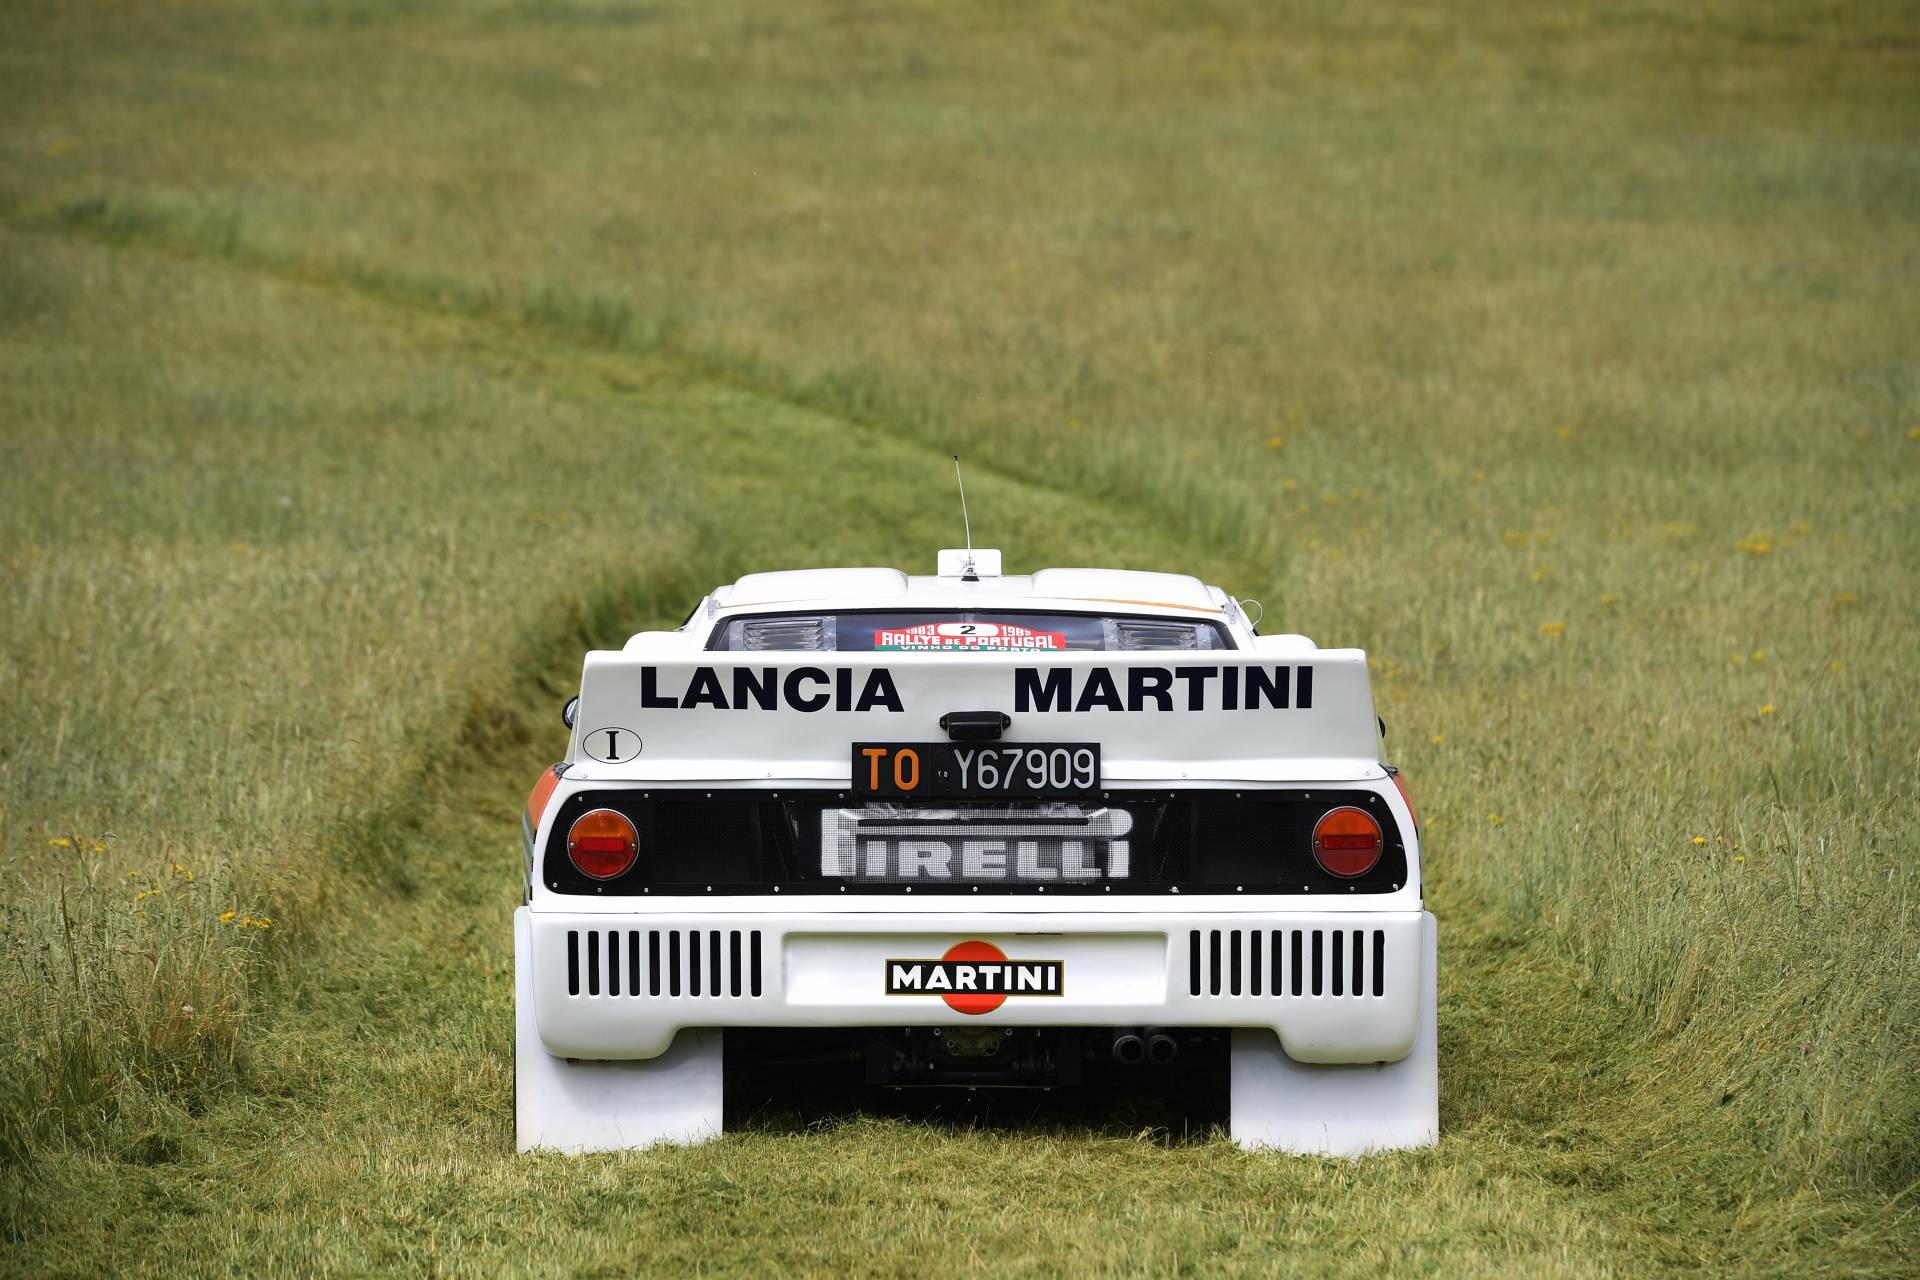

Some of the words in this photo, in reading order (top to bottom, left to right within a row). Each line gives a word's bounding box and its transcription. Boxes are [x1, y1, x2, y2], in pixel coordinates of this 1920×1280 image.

[881, 632, 941, 646] RALLYE
[965, 633, 1057, 648] PORTUGAL
[959, 625, 977, 635] 2
[640, 666, 904, 713] LANCIA
[1014, 665, 1313, 713] MARTINI
[605, 730, 619, 760] I
[862, 748, 919, 790] TO
[954, 748, 1095, 789] Y67909
[821, 808, 1133, 878] PIRELLI
[892, 964, 1056, 991] MARTINI
